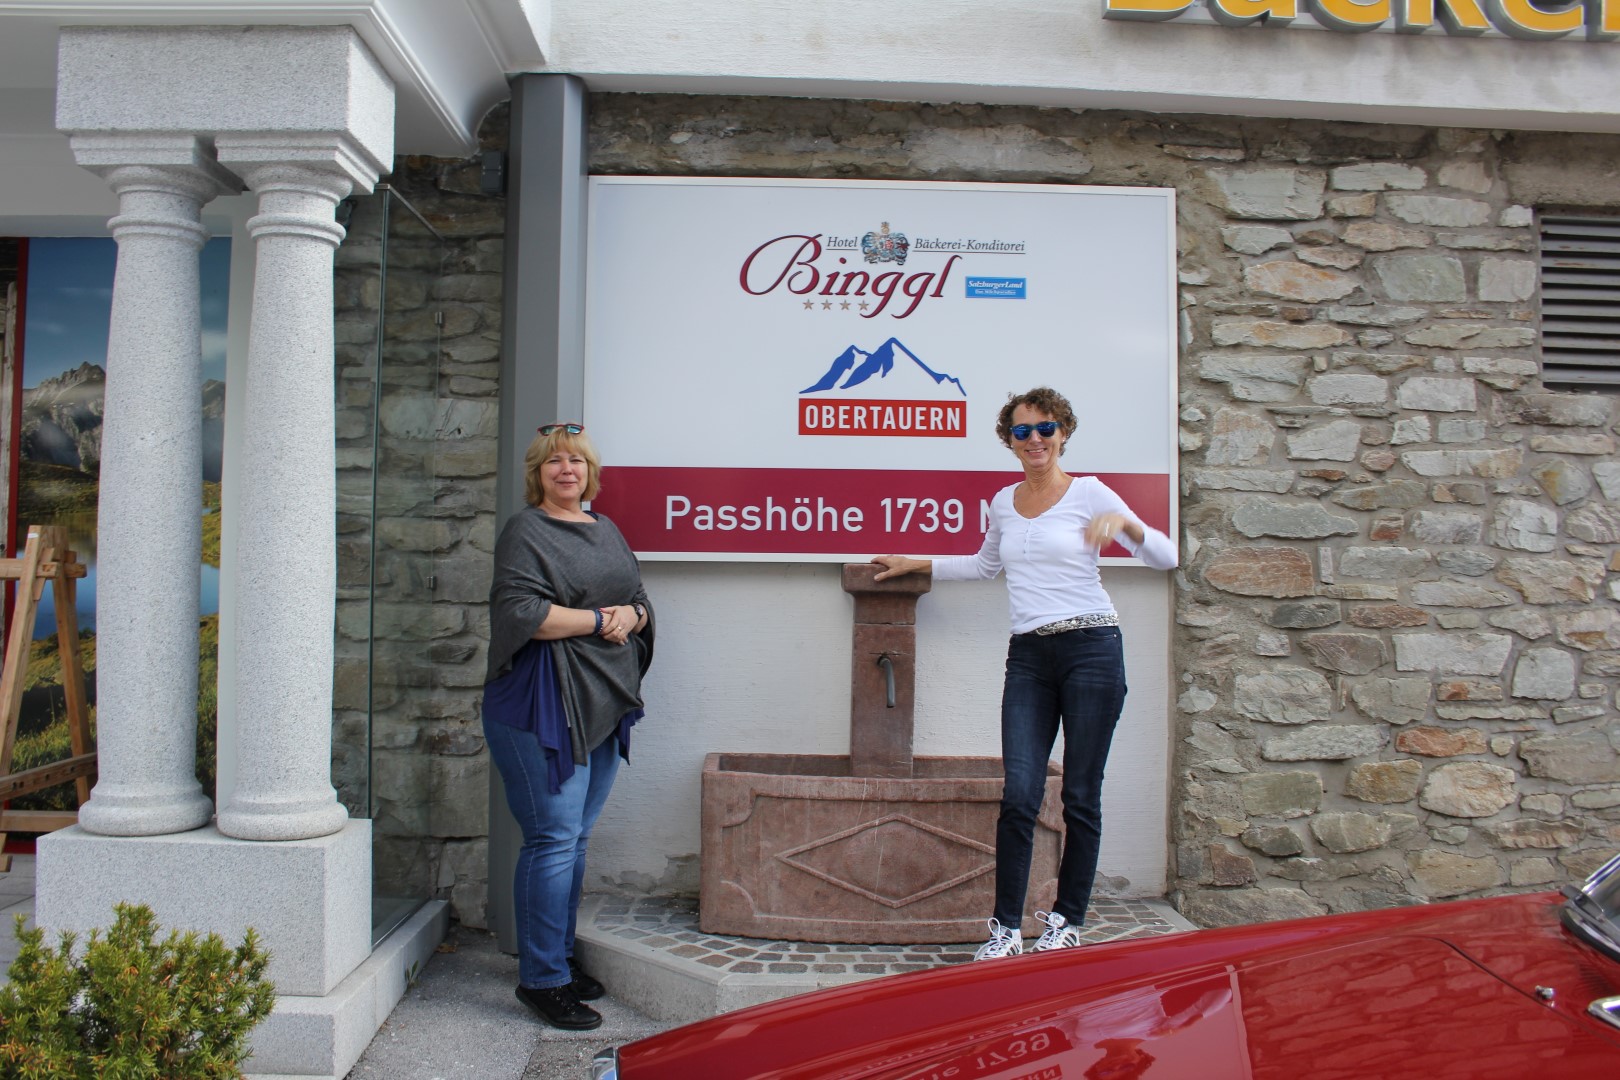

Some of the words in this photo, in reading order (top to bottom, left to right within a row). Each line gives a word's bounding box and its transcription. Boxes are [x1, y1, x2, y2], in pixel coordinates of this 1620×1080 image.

[827, 236, 858, 248] Hotel
[914, 238, 1025, 252] Bäckerei-Konditorei
[739, 234, 962, 319] Binggl
[805, 405, 961, 431] OBERTAUERN
[665, 495, 864, 532] Passhöhe
[880, 498, 964, 533] 1739
